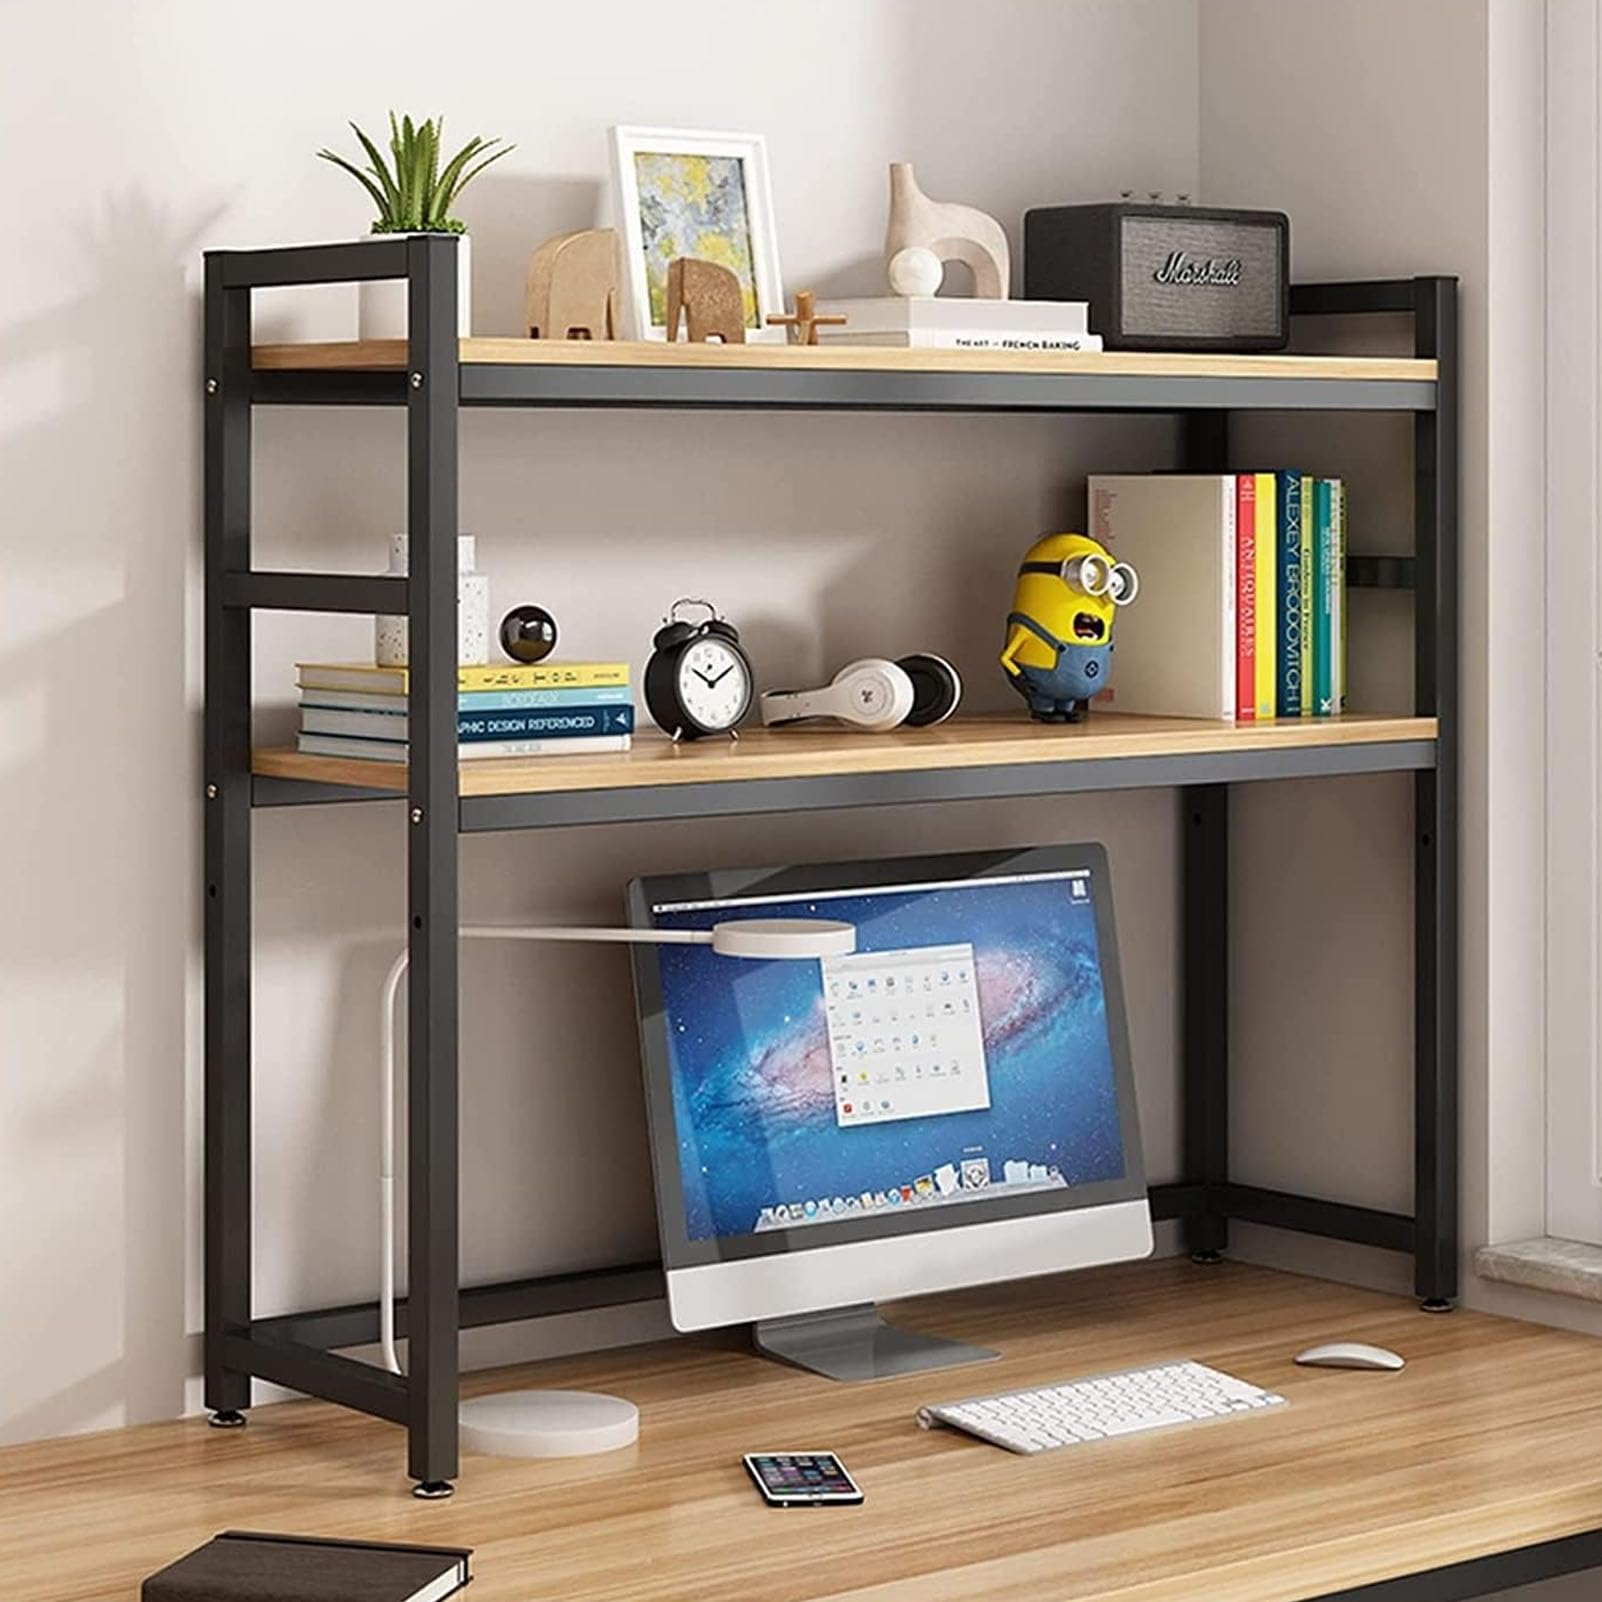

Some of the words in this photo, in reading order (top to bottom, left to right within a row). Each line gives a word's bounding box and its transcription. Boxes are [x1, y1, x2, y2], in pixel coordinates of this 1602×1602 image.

[1155, 251, 1241, 286] Marshall
[1042, 340, 1081, 351] BAKING
[1286, 475, 1301, 557] ALEXEY
[487, 719, 526, 733] DESIGN
[528, 716, 595, 731] REFERENCED
